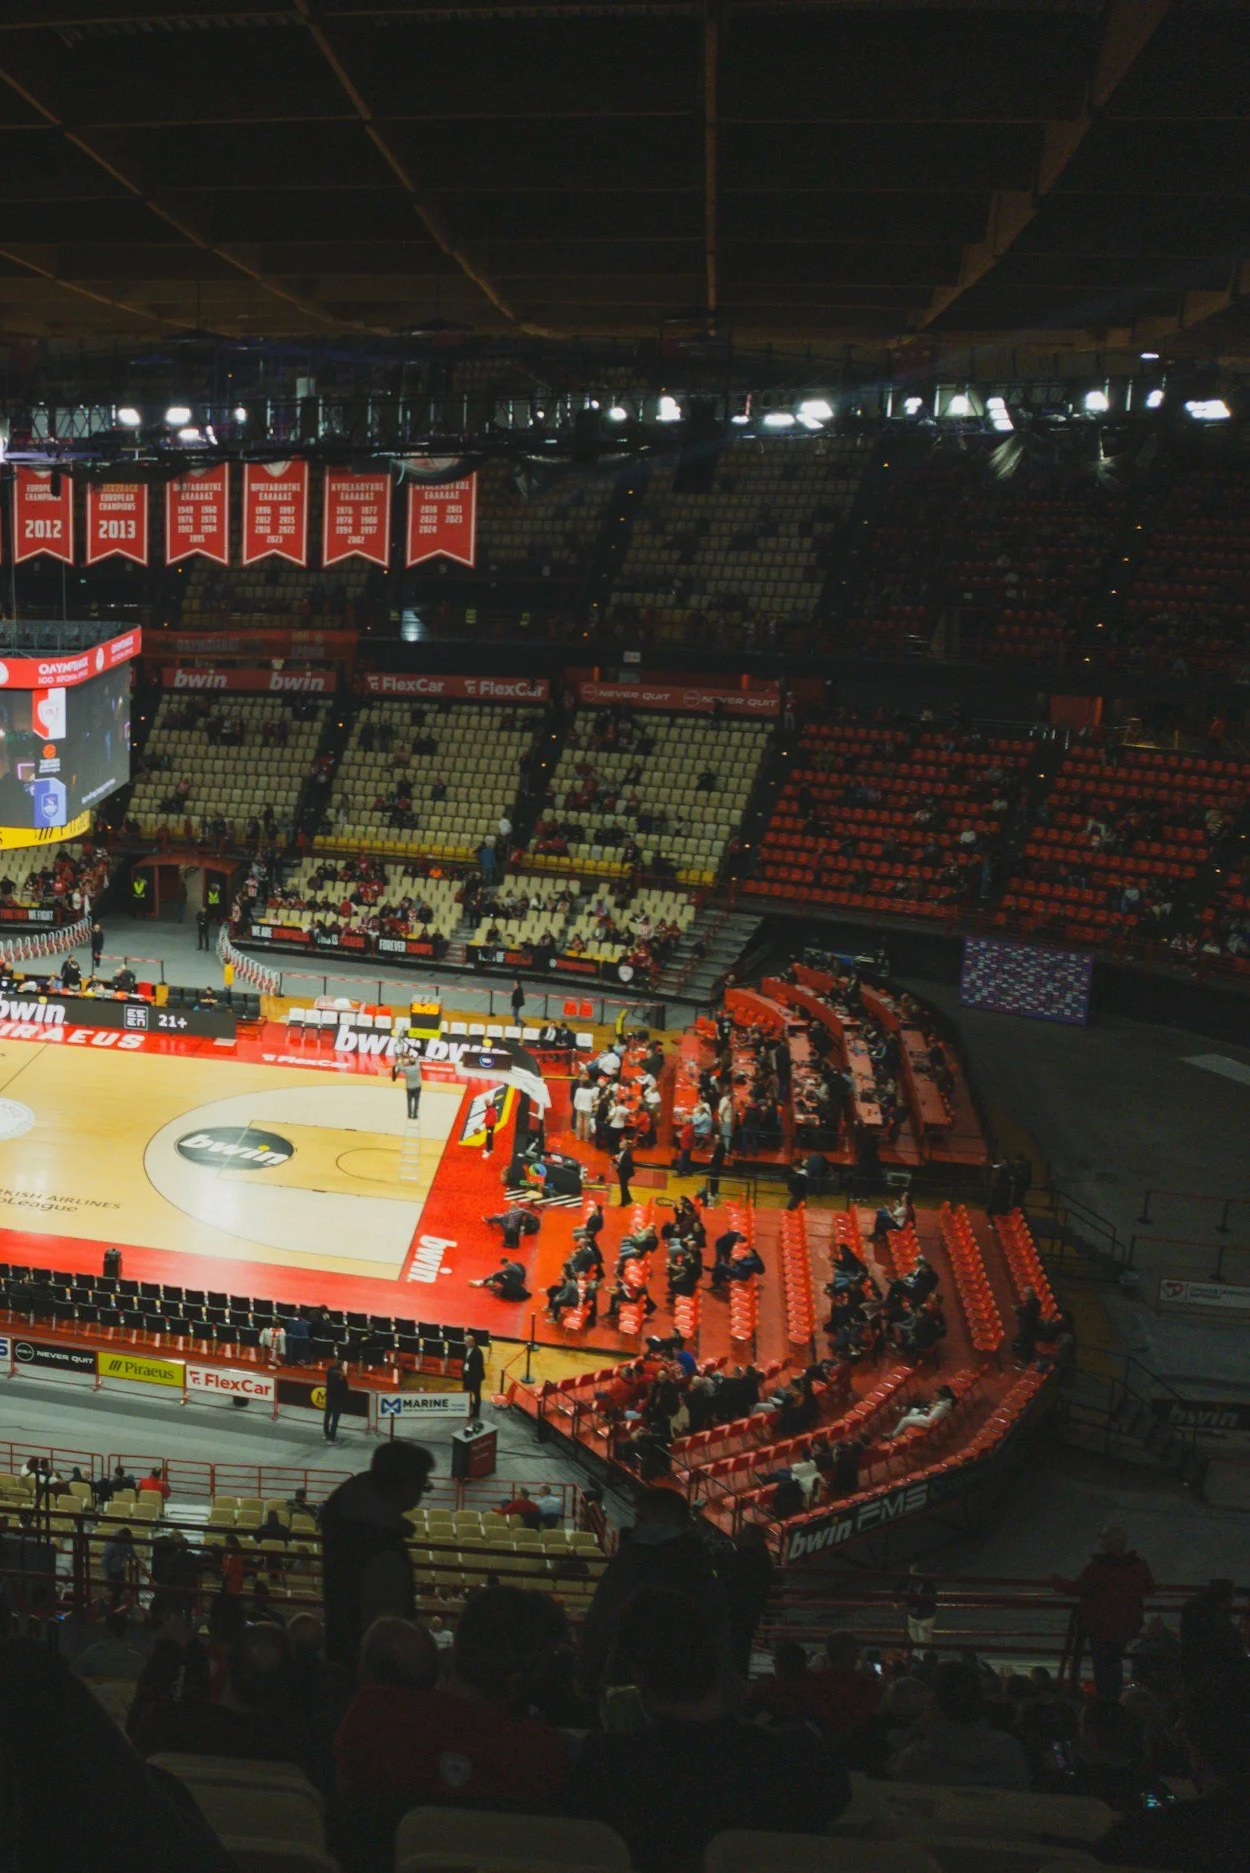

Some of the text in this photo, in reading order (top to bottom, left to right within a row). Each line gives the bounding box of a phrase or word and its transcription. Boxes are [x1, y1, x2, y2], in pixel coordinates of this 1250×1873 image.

[25, 519, 62, 538] 2012
[98, 520, 137, 539] 2013
[382, 676, 445, 693] FlexCar
[599, 689, 640, 700] NEVER
[642, 692, 672, 702] QUIT
[747, 697, 778, 708] QUIT
[379, 938, 406, 953] FOREVER
[158, 1013, 188, 1029] 21+
[178, 1133, 292, 1167] bwin
[47, 1194, 124, 1210] AIRLINES
[36, 1351, 69, 1362] NEVER
[71, 1355, 94, 1365] QUIT
[125, 1361, 174, 1380] Piraeus
[205, 1373, 271, 1396] FlexCar
[403, 1399, 449, 1409] MARINE
[789, 1516, 853, 1560] bwin
[857, 1484, 928, 1530] FMS
